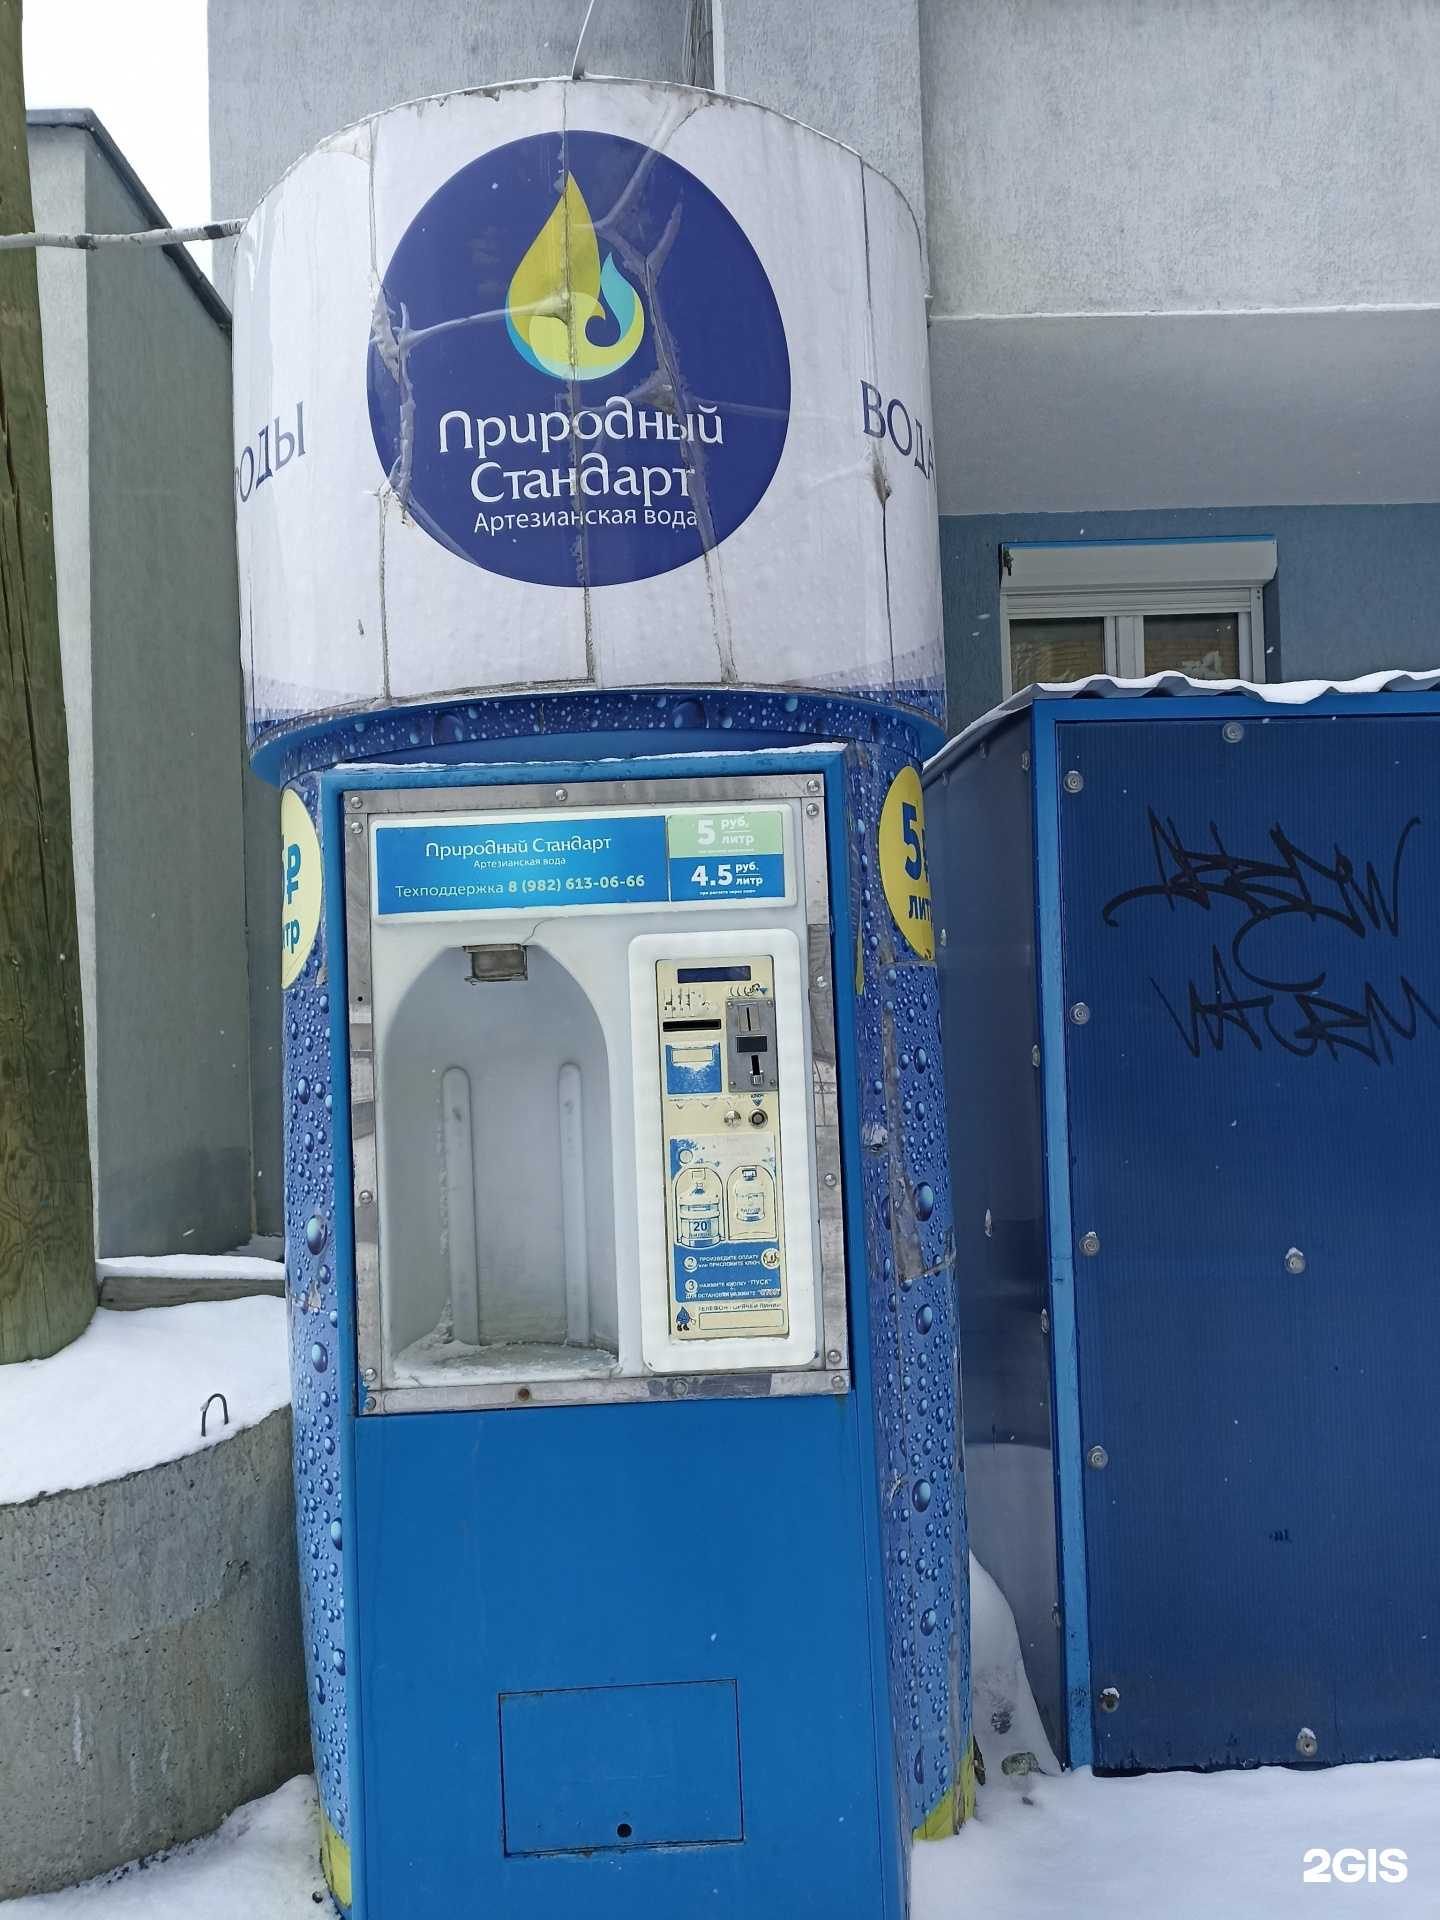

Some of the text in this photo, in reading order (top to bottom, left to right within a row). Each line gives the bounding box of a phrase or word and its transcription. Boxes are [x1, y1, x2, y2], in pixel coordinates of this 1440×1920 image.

[439, 395, 723, 459] Природный
[470, 452, 696, 507] Стандарт
[474, 508, 698, 536] Артезианская вода
[697, 816, 749, 845] 5 руб.
[721, 835, 755, 846] литр
[902, 801, 928, 882] 5
[425, 835, 612, 860] Природный Стандарт
[473, 857, 566, 870] Артезианская вода
[691, 861, 759, 886] 4.5 руб.
[394, 875, 645, 897] Техподдержка 8 (982) 613-06-66
[735, 876, 764, 887] литр
[909, 895, 933, 928] лит
[693, 1221, 708, 1232] 20
